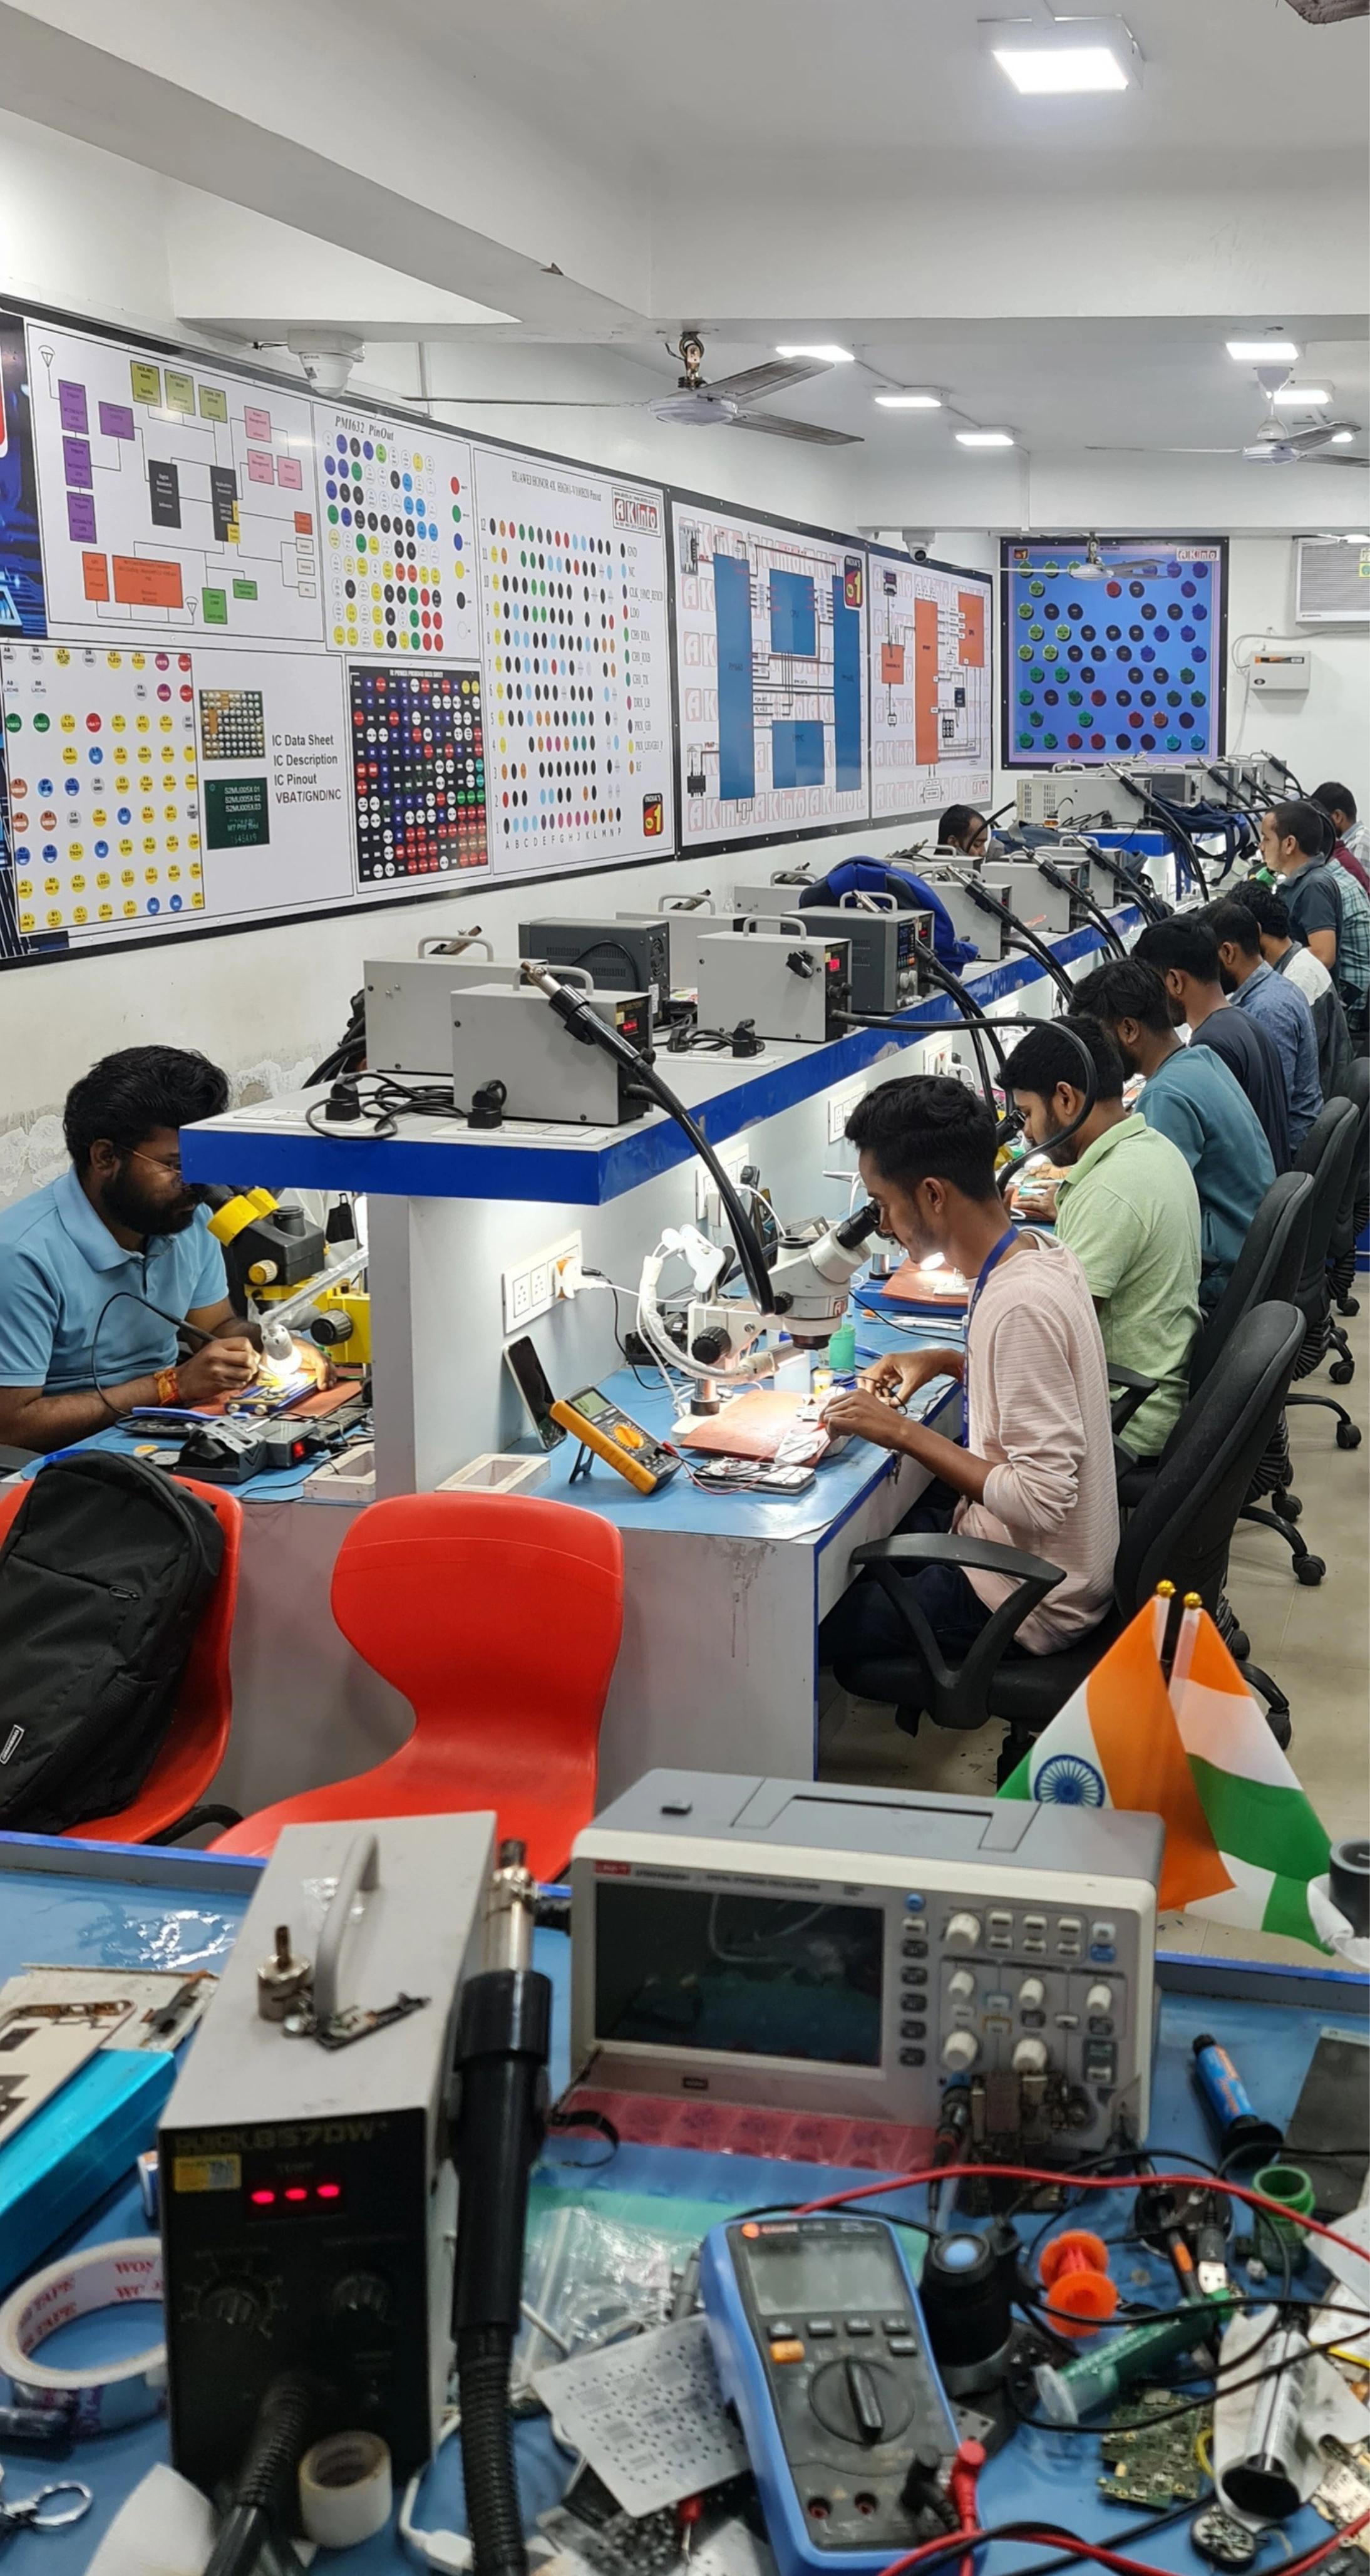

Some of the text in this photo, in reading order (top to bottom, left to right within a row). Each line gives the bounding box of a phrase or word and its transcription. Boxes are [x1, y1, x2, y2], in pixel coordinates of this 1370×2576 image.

[335, 415, 394, 441] PMI632 PinOut
[854, 571, 861, 604] 1
[272, 734, 334, 746] IC Data Sheet
[274, 753, 337, 767] IC Description
[274, 773, 317, 786] IC Pinout
[276, 789, 341, 804] VBAT/GND/NC
[654, 804, 661, 832] 1
